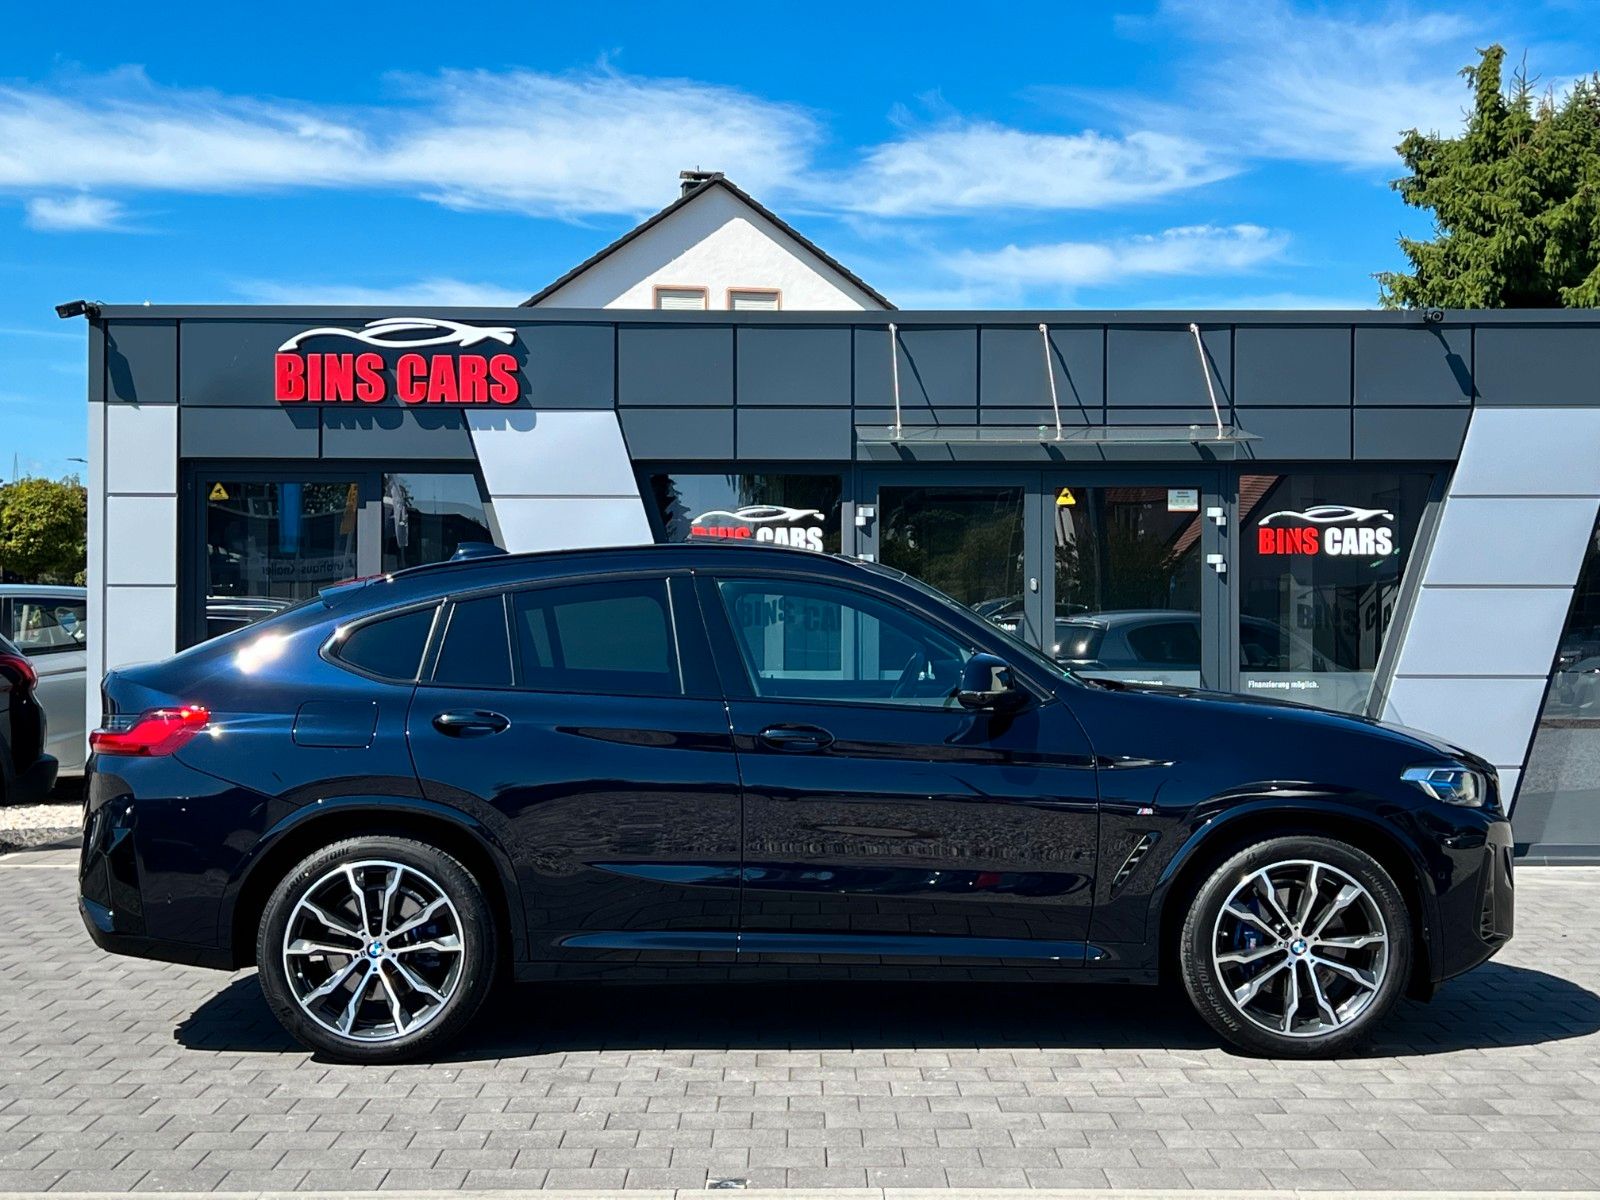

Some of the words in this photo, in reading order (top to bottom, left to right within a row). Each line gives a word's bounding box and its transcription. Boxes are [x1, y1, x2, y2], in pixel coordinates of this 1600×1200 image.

[275, 353, 386, 403] BINS
[397, 353, 519, 404] CARS
[756, 526, 823, 552] CARS
[1258, 527, 1319, 555] BINS
[1324, 527, 1393, 556] CARS
[1248, 680, 1290, 689] Finanzierung
